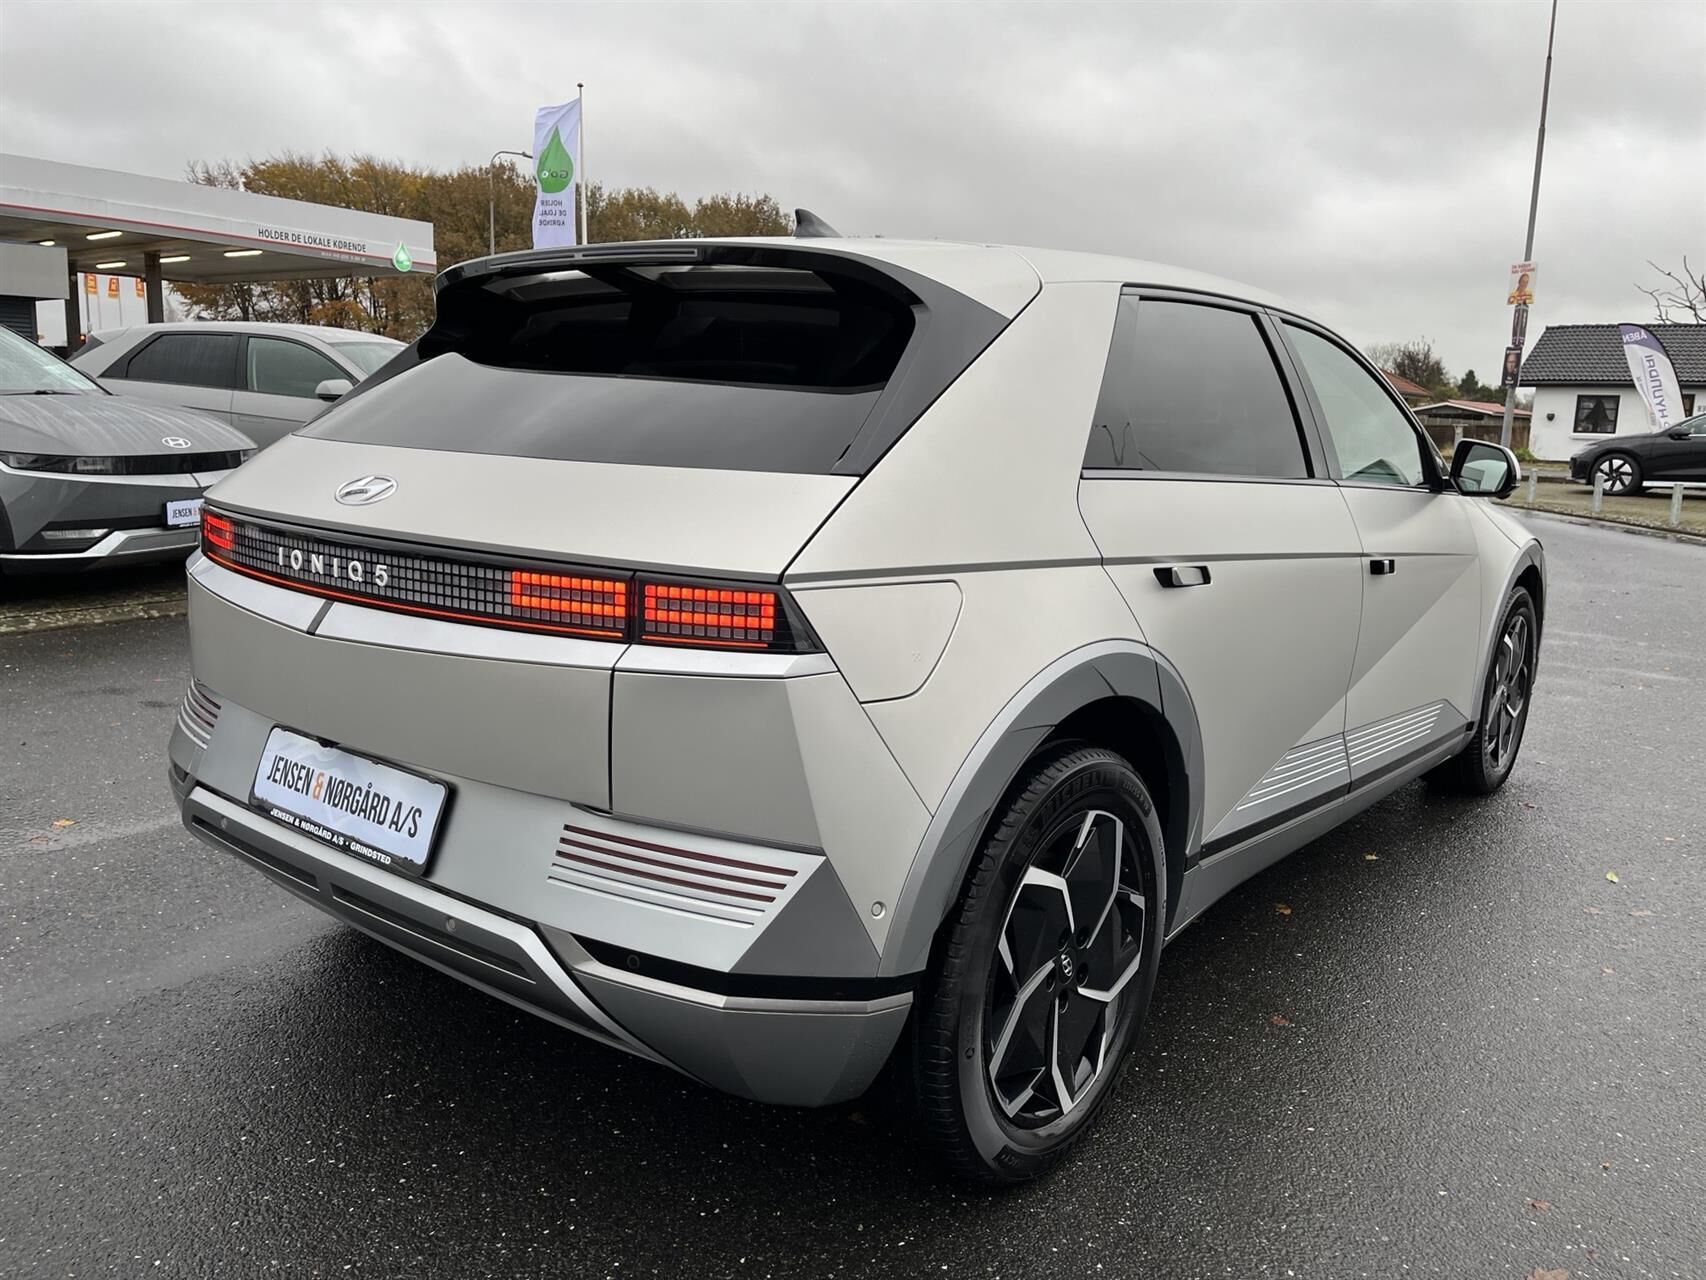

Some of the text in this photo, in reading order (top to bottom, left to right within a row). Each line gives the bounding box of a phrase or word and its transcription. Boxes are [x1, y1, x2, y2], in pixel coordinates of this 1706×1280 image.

[258, 228, 367, 253] HOLDER DE LOKALE KØRENDE
[278, 546, 388, 587] IONIQ 5
[266, 754, 422, 839] JENSEN & NØRGÅRD A/S
[270, 807, 392, 865] JENSEN & NØRGÅRD A/S GRINDSTED
